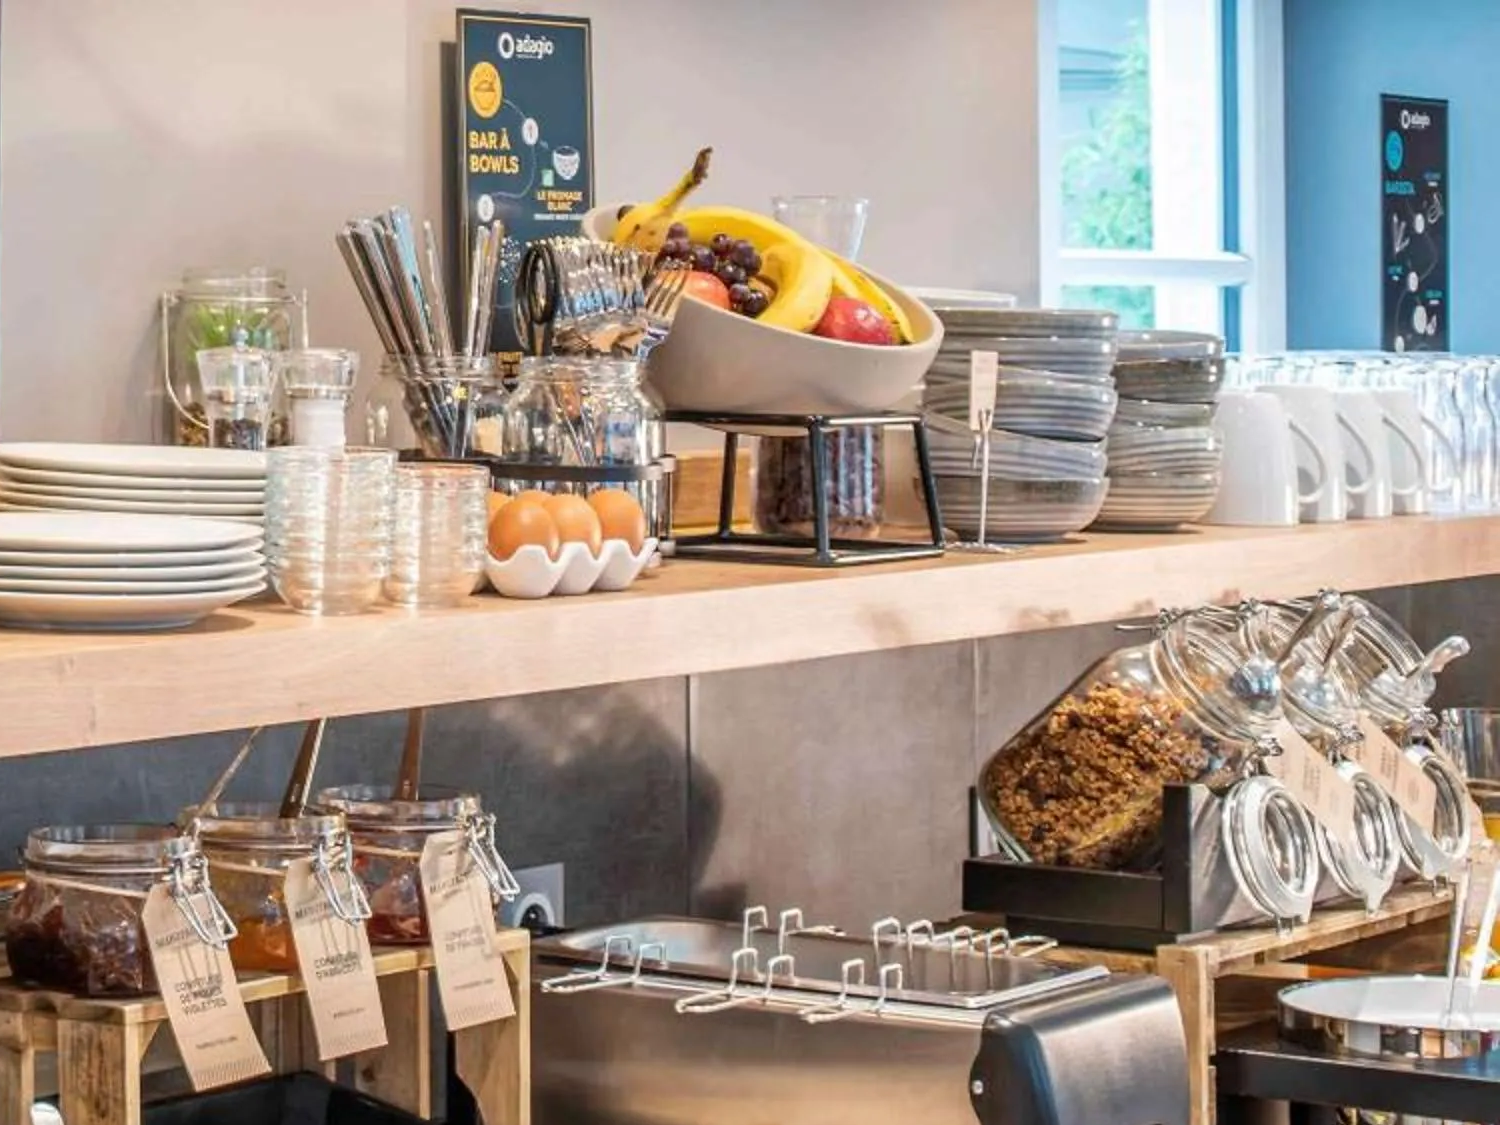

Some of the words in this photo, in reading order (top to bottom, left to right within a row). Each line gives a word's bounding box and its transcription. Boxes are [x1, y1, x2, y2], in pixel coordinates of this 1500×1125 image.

[515, 33, 554, 59] adagio
[469, 130, 497, 149] BAR
[499, 127, 511, 151] À
[469, 154, 519, 174] BOWLS
